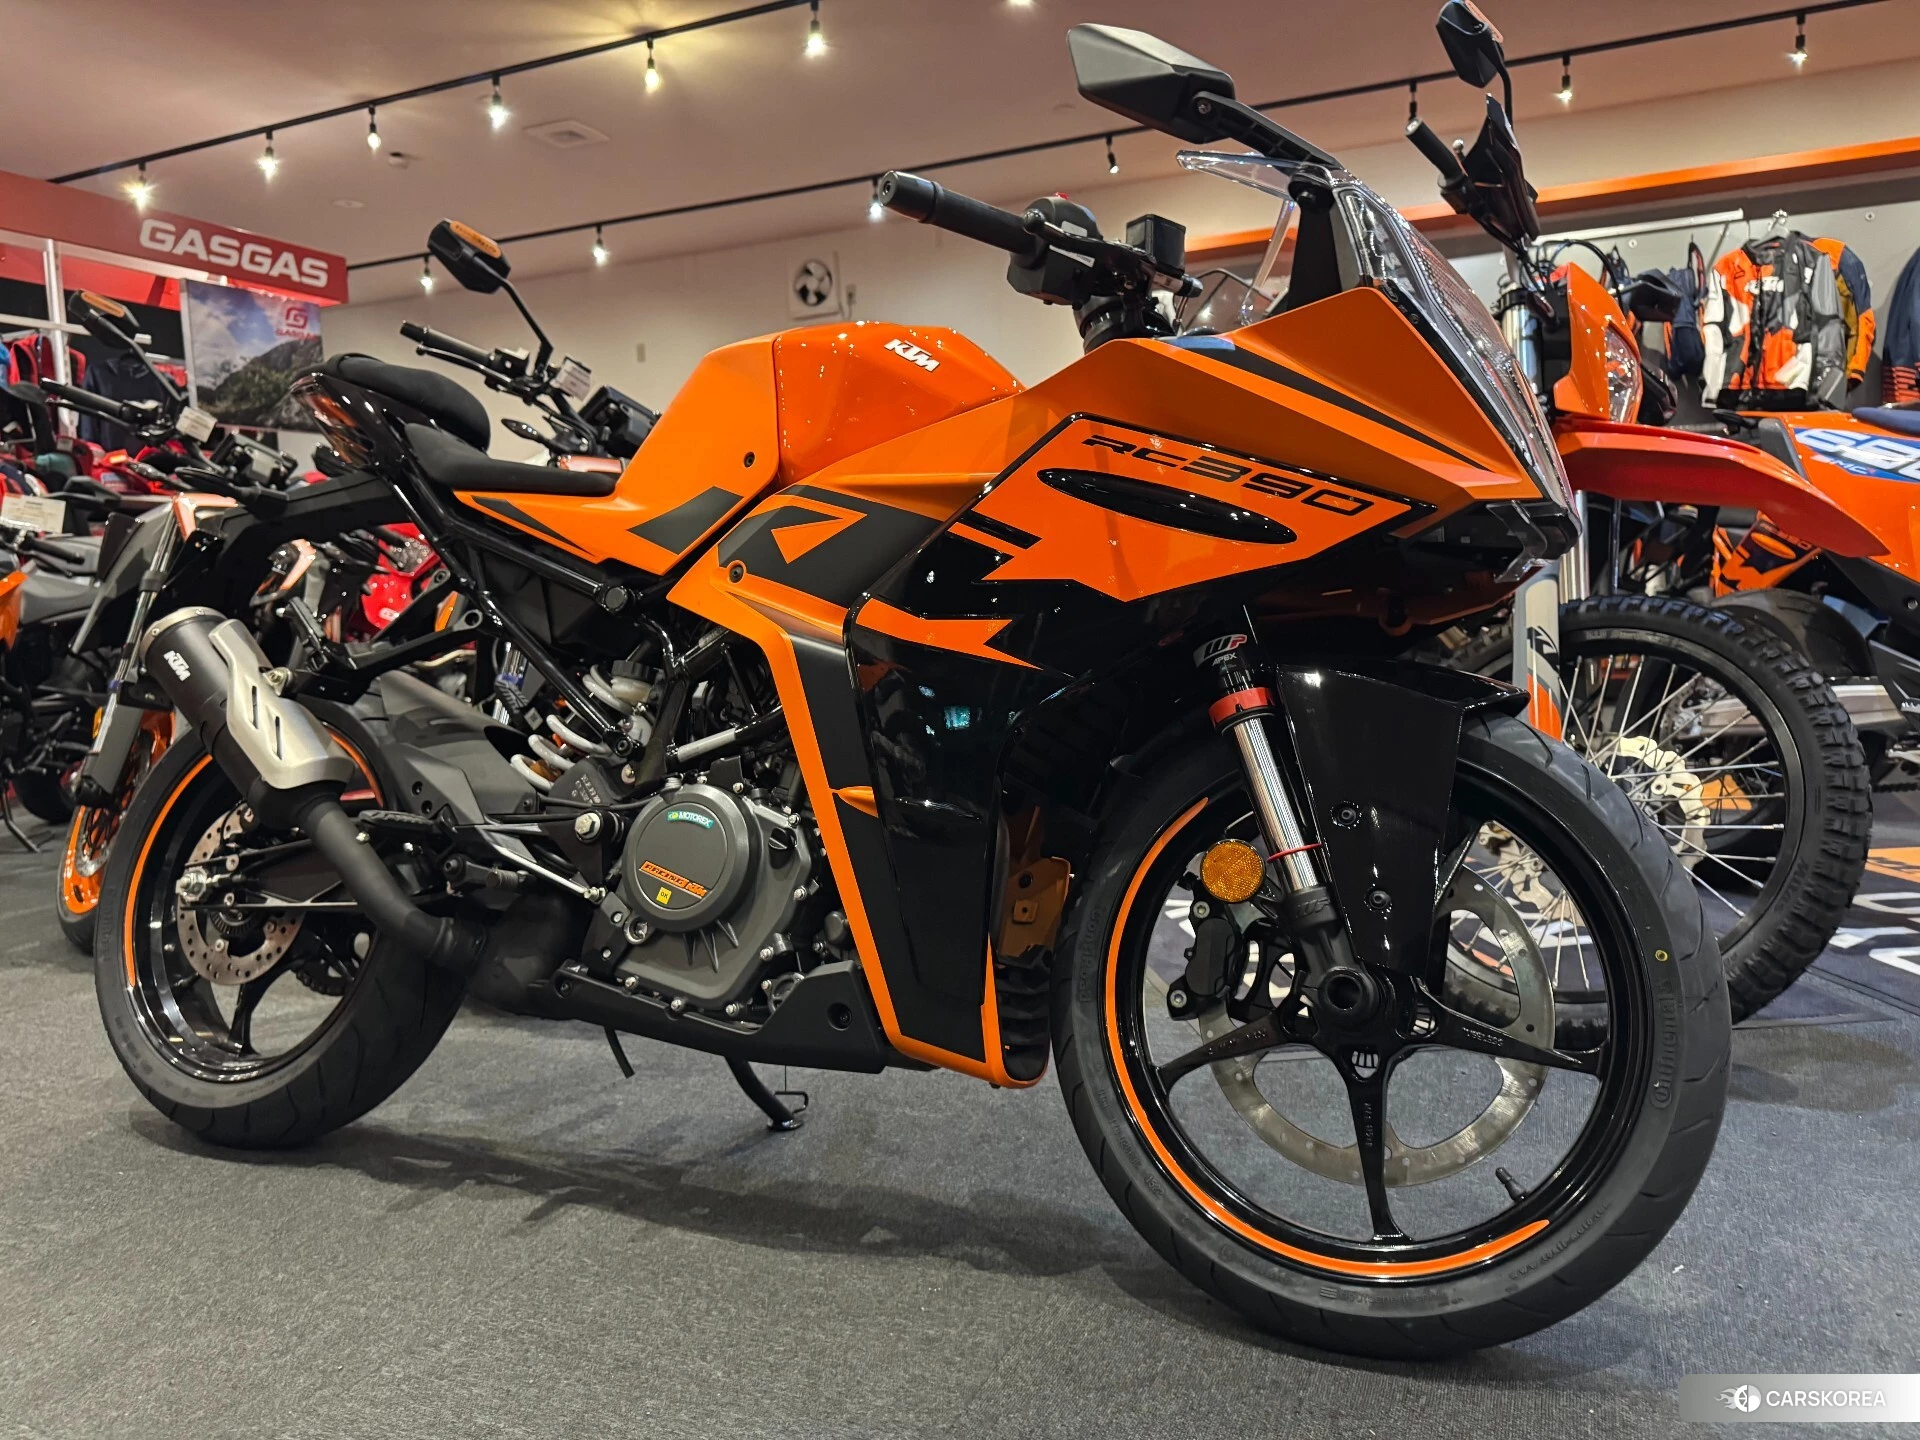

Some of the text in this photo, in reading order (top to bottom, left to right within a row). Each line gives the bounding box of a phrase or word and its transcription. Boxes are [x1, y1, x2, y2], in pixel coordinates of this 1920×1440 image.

[139, 218, 329, 289] GASGAS
[884, 338, 941, 374] KTM
[1081, 435, 1375, 517] RC390
[163, 650, 191, 682] KTM
[1211, 652, 1238, 667] APEX
[678, 811, 713, 827] MOTOREX
